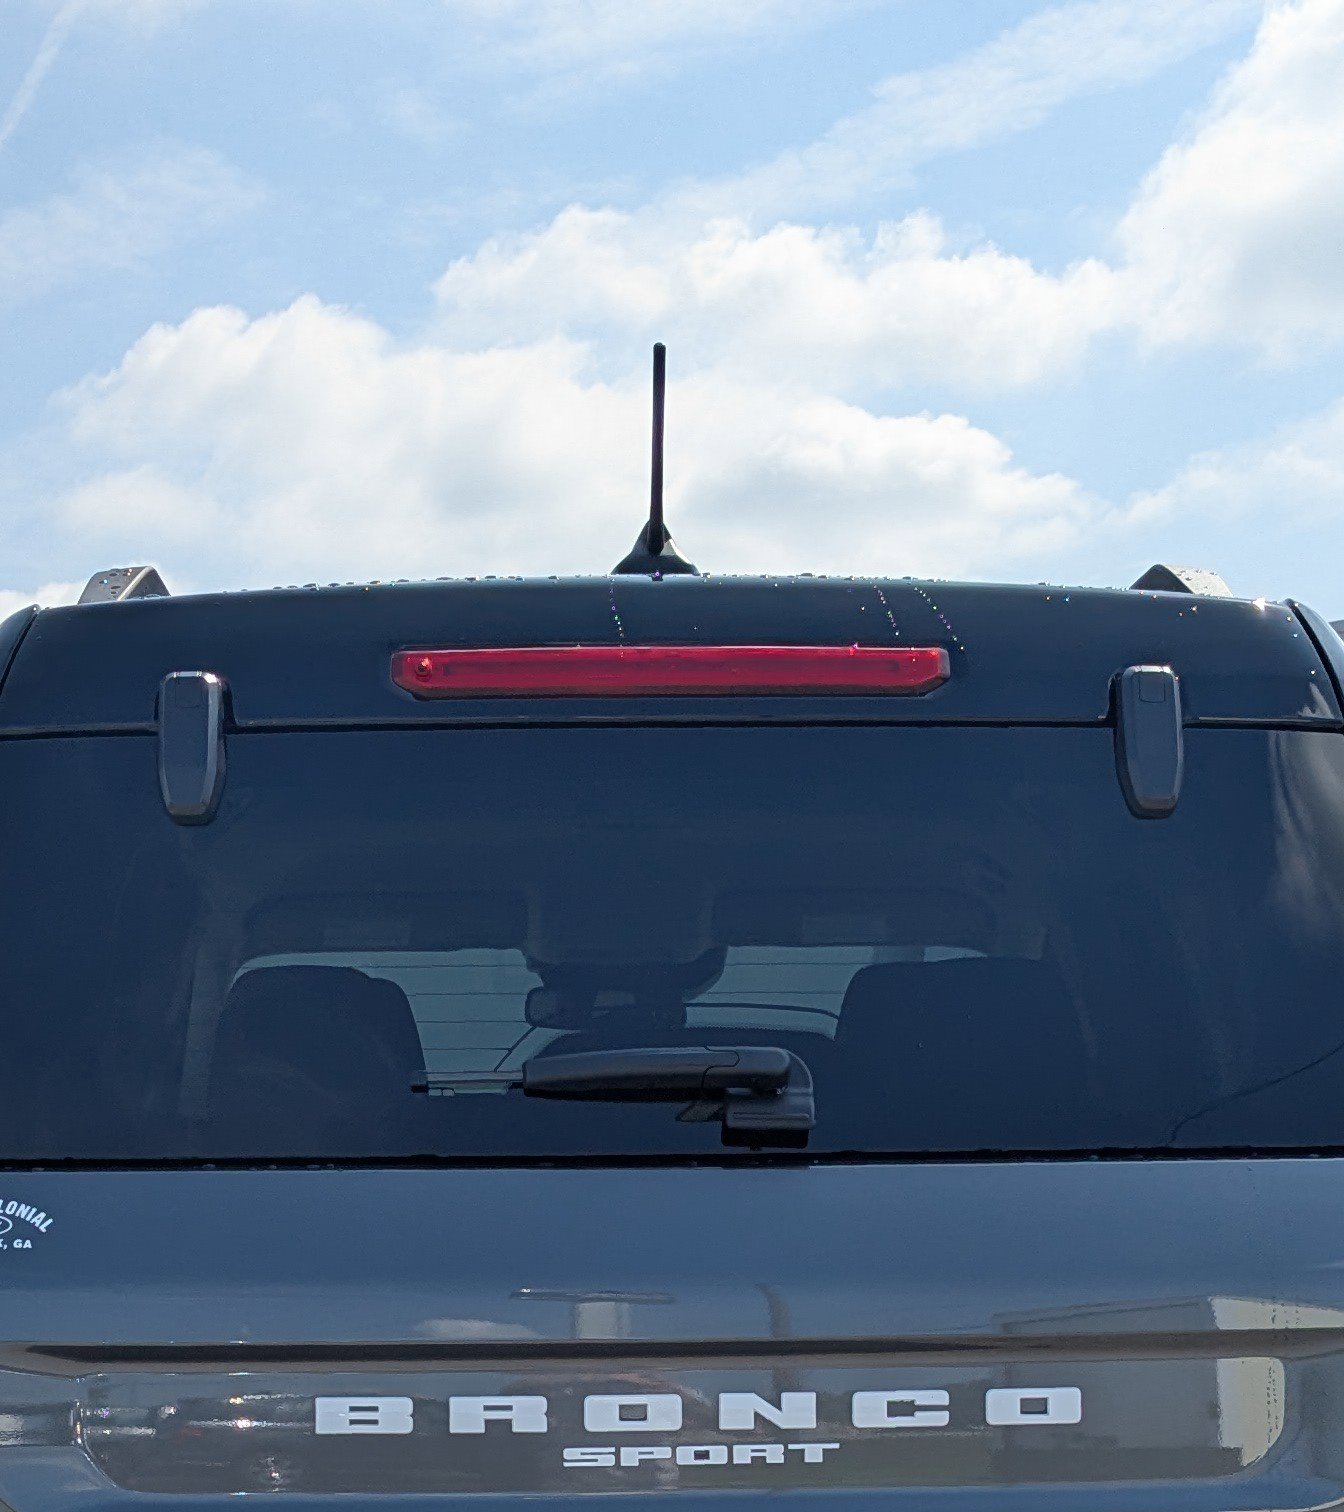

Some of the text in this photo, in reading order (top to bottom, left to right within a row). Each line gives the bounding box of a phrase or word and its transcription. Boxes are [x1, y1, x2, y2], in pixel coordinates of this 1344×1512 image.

[13, 1239, 33, 1249] GA
[315, 1386, 1082, 1435] BRONCO
[562, 1442, 841, 1468] SPORT
